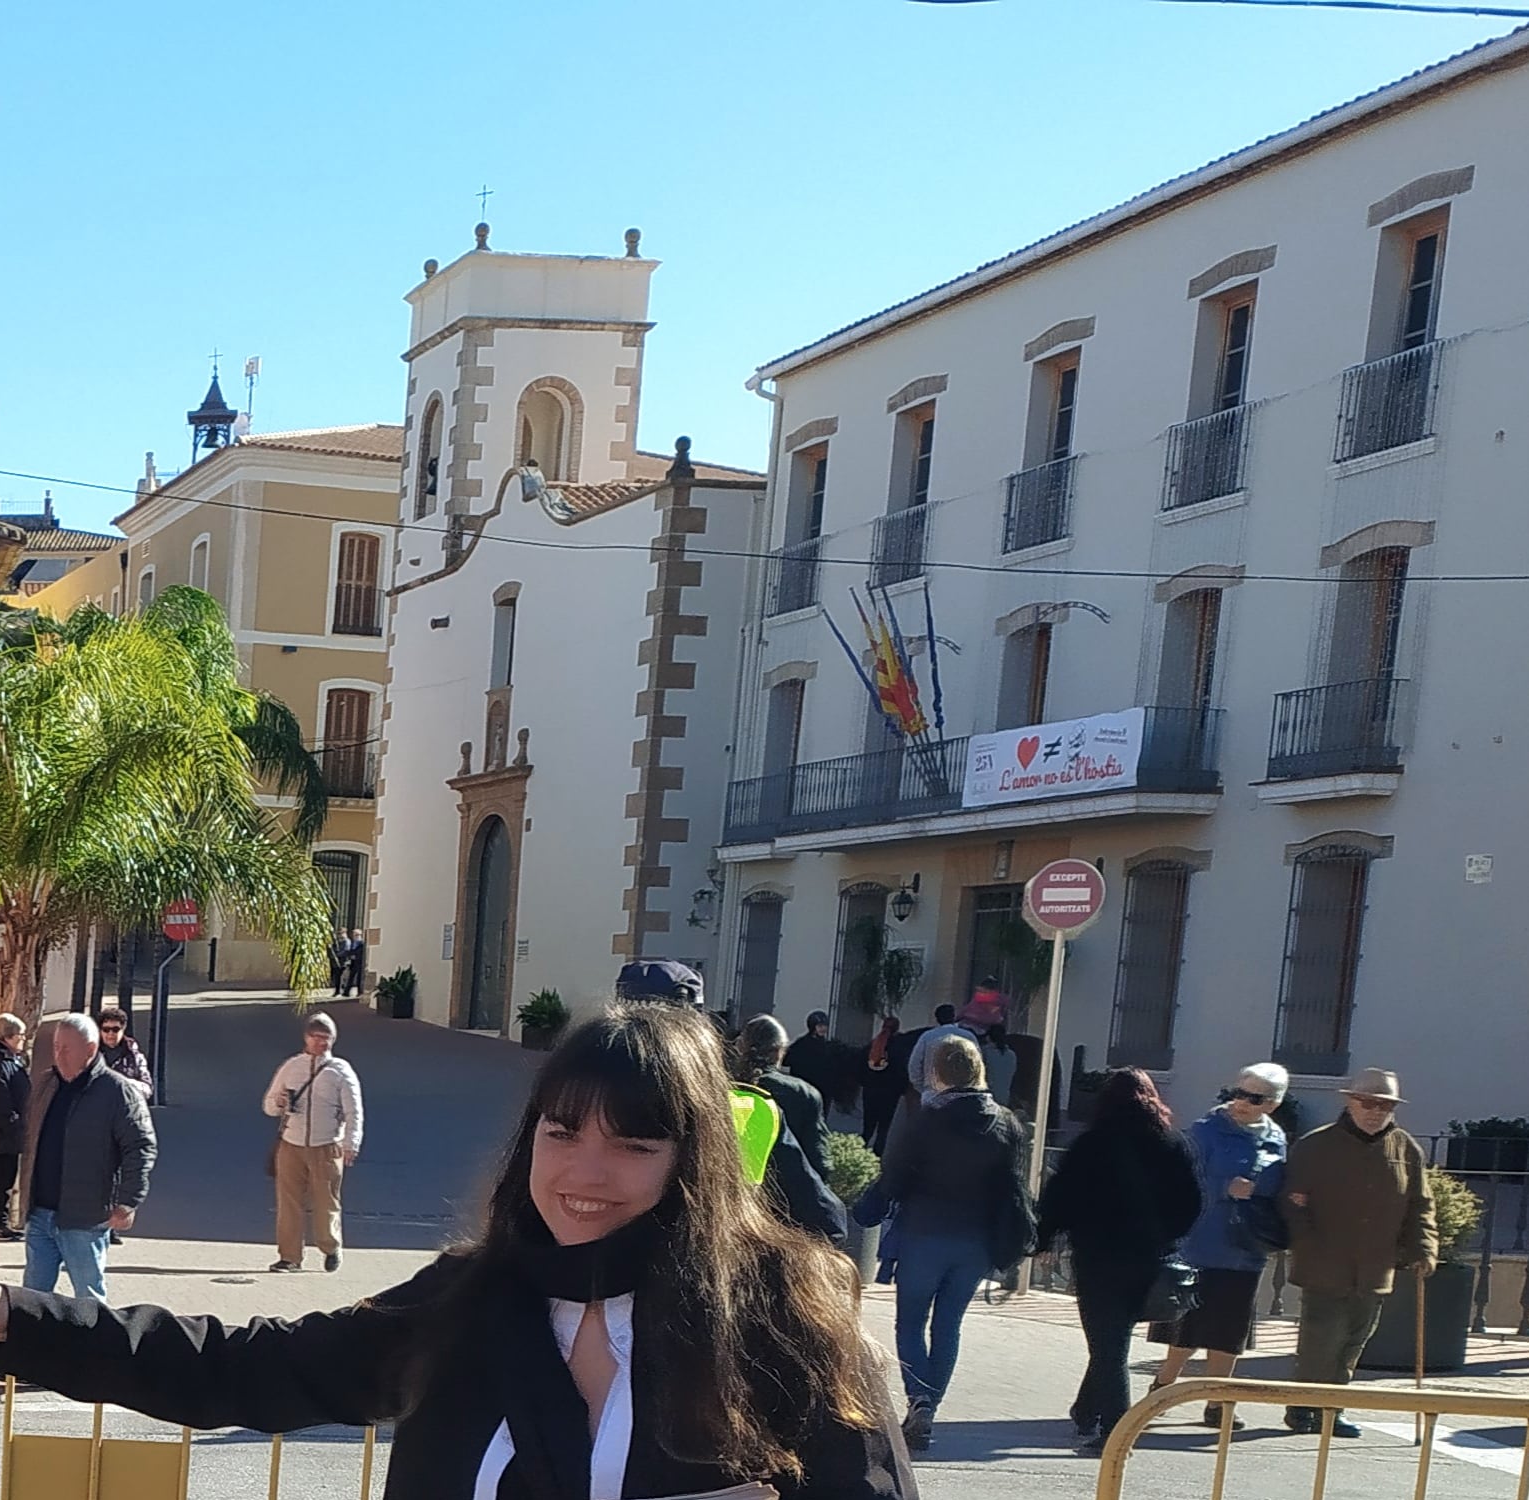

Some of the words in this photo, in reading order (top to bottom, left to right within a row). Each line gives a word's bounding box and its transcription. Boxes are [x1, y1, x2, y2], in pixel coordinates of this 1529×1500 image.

[1044, 772, 1058, 785] no
[1049, 874, 1087, 882] EXCEPTE
[1039, 905, 1090, 913] AUTORITZATS
